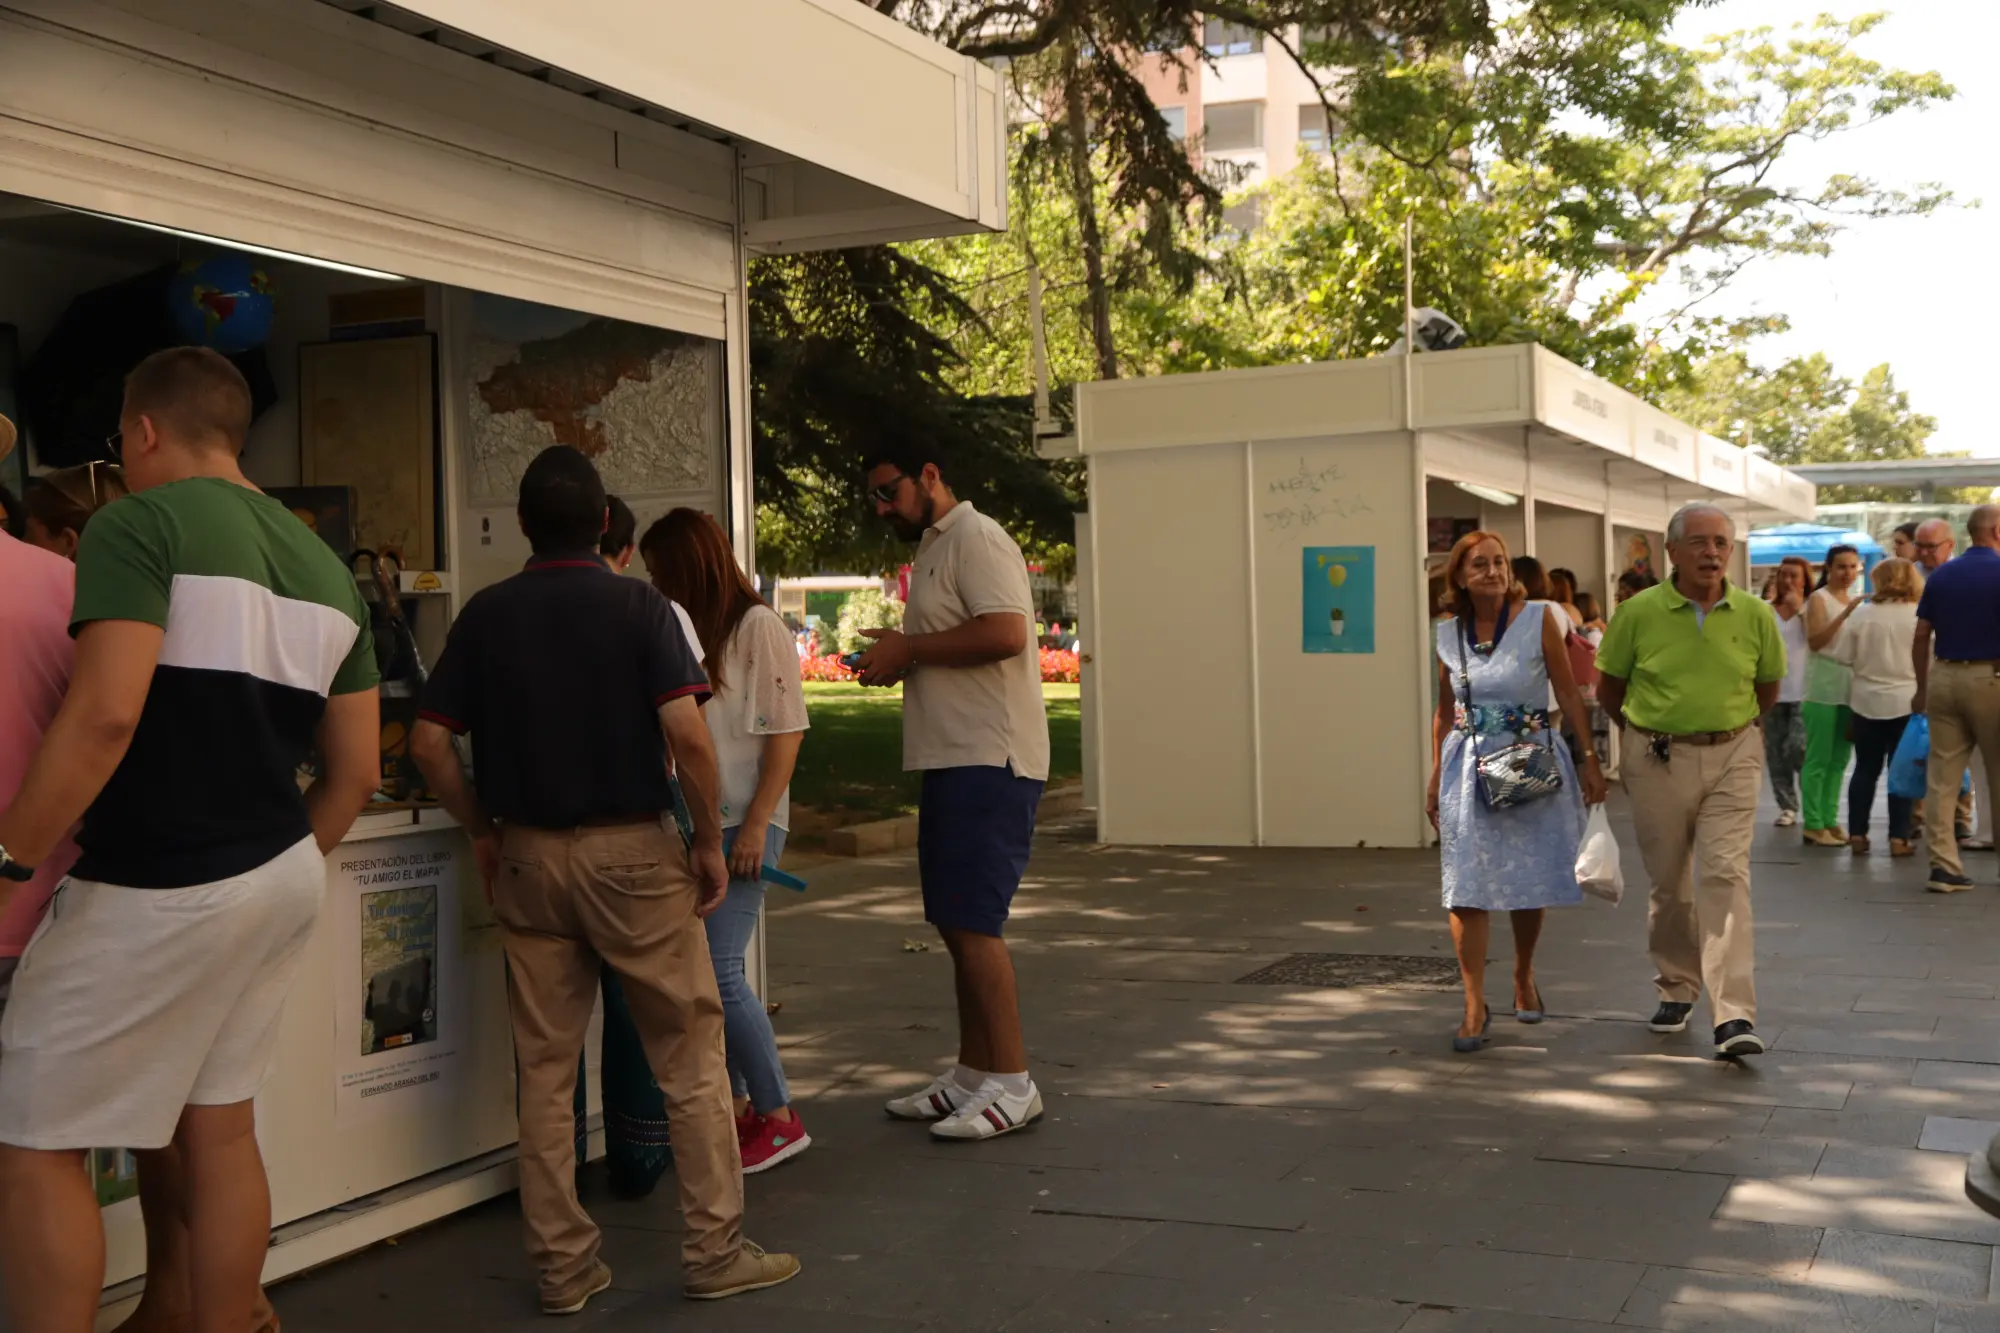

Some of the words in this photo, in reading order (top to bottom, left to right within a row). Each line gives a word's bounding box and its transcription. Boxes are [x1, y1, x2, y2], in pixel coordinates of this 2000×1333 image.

[410, 853, 426, 865] DEL
[427, 851, 452, 863] LIBRO
[371, 871, 401, 884] AMIGO
[402, 869, 413, 880] EL
[360, 1082, 394, 1098] FERNANDO
